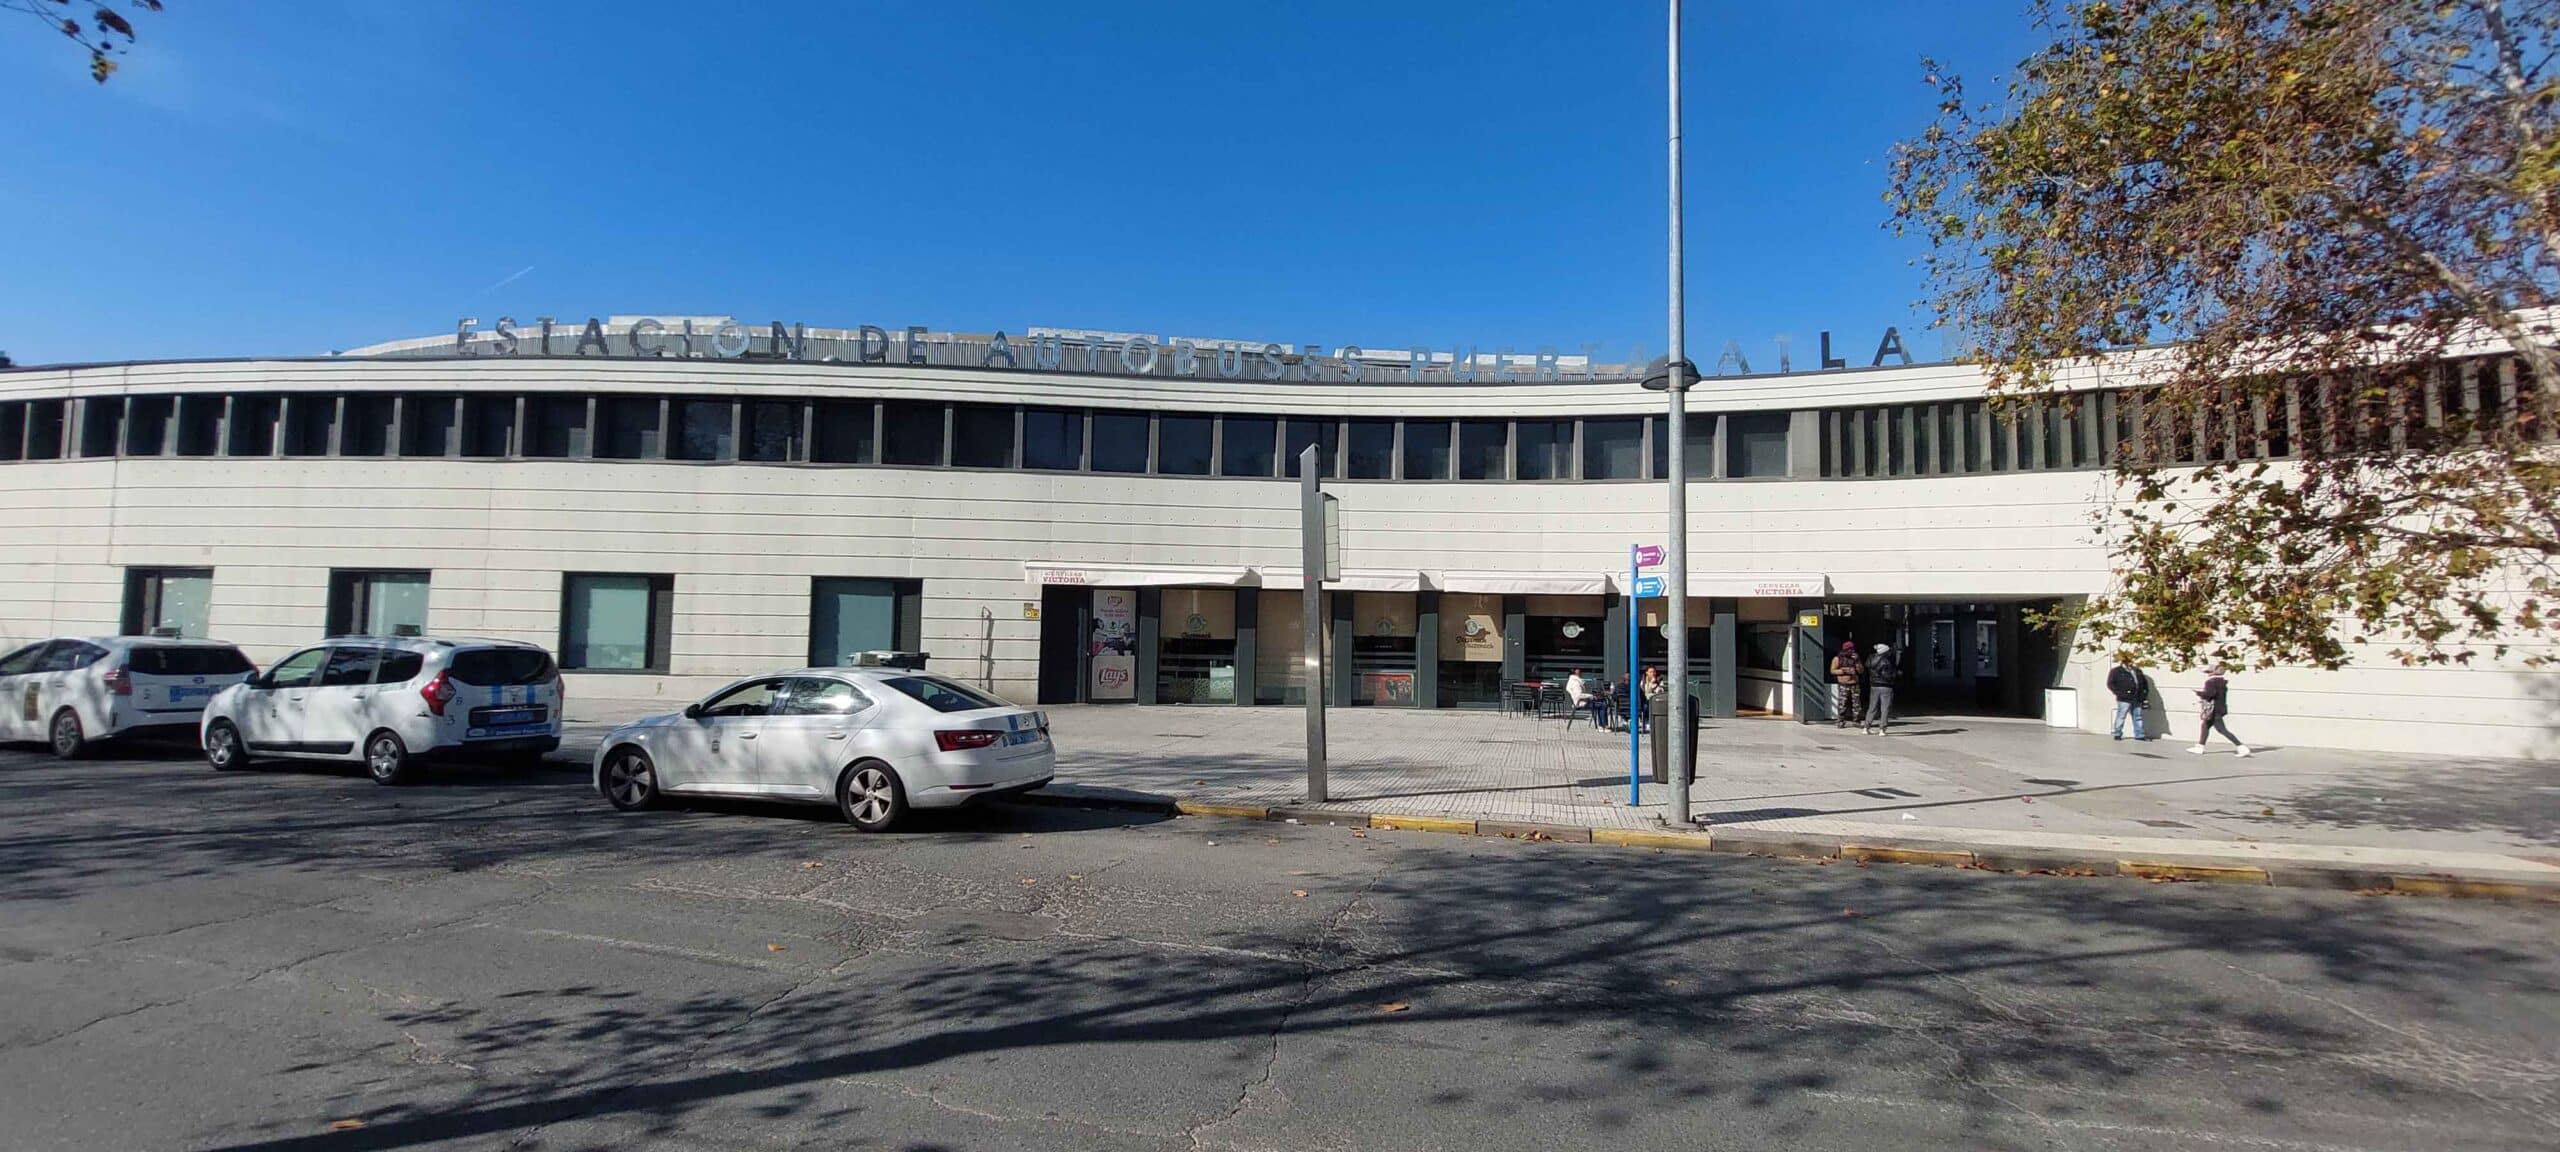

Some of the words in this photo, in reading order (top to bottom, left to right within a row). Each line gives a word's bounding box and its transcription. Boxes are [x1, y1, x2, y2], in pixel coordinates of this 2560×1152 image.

[859, 324, 928, 364] DE
[984, 330, 1364, 383] AUTOBUSES
[1042, 576, 1086, 584] VICTORIA
